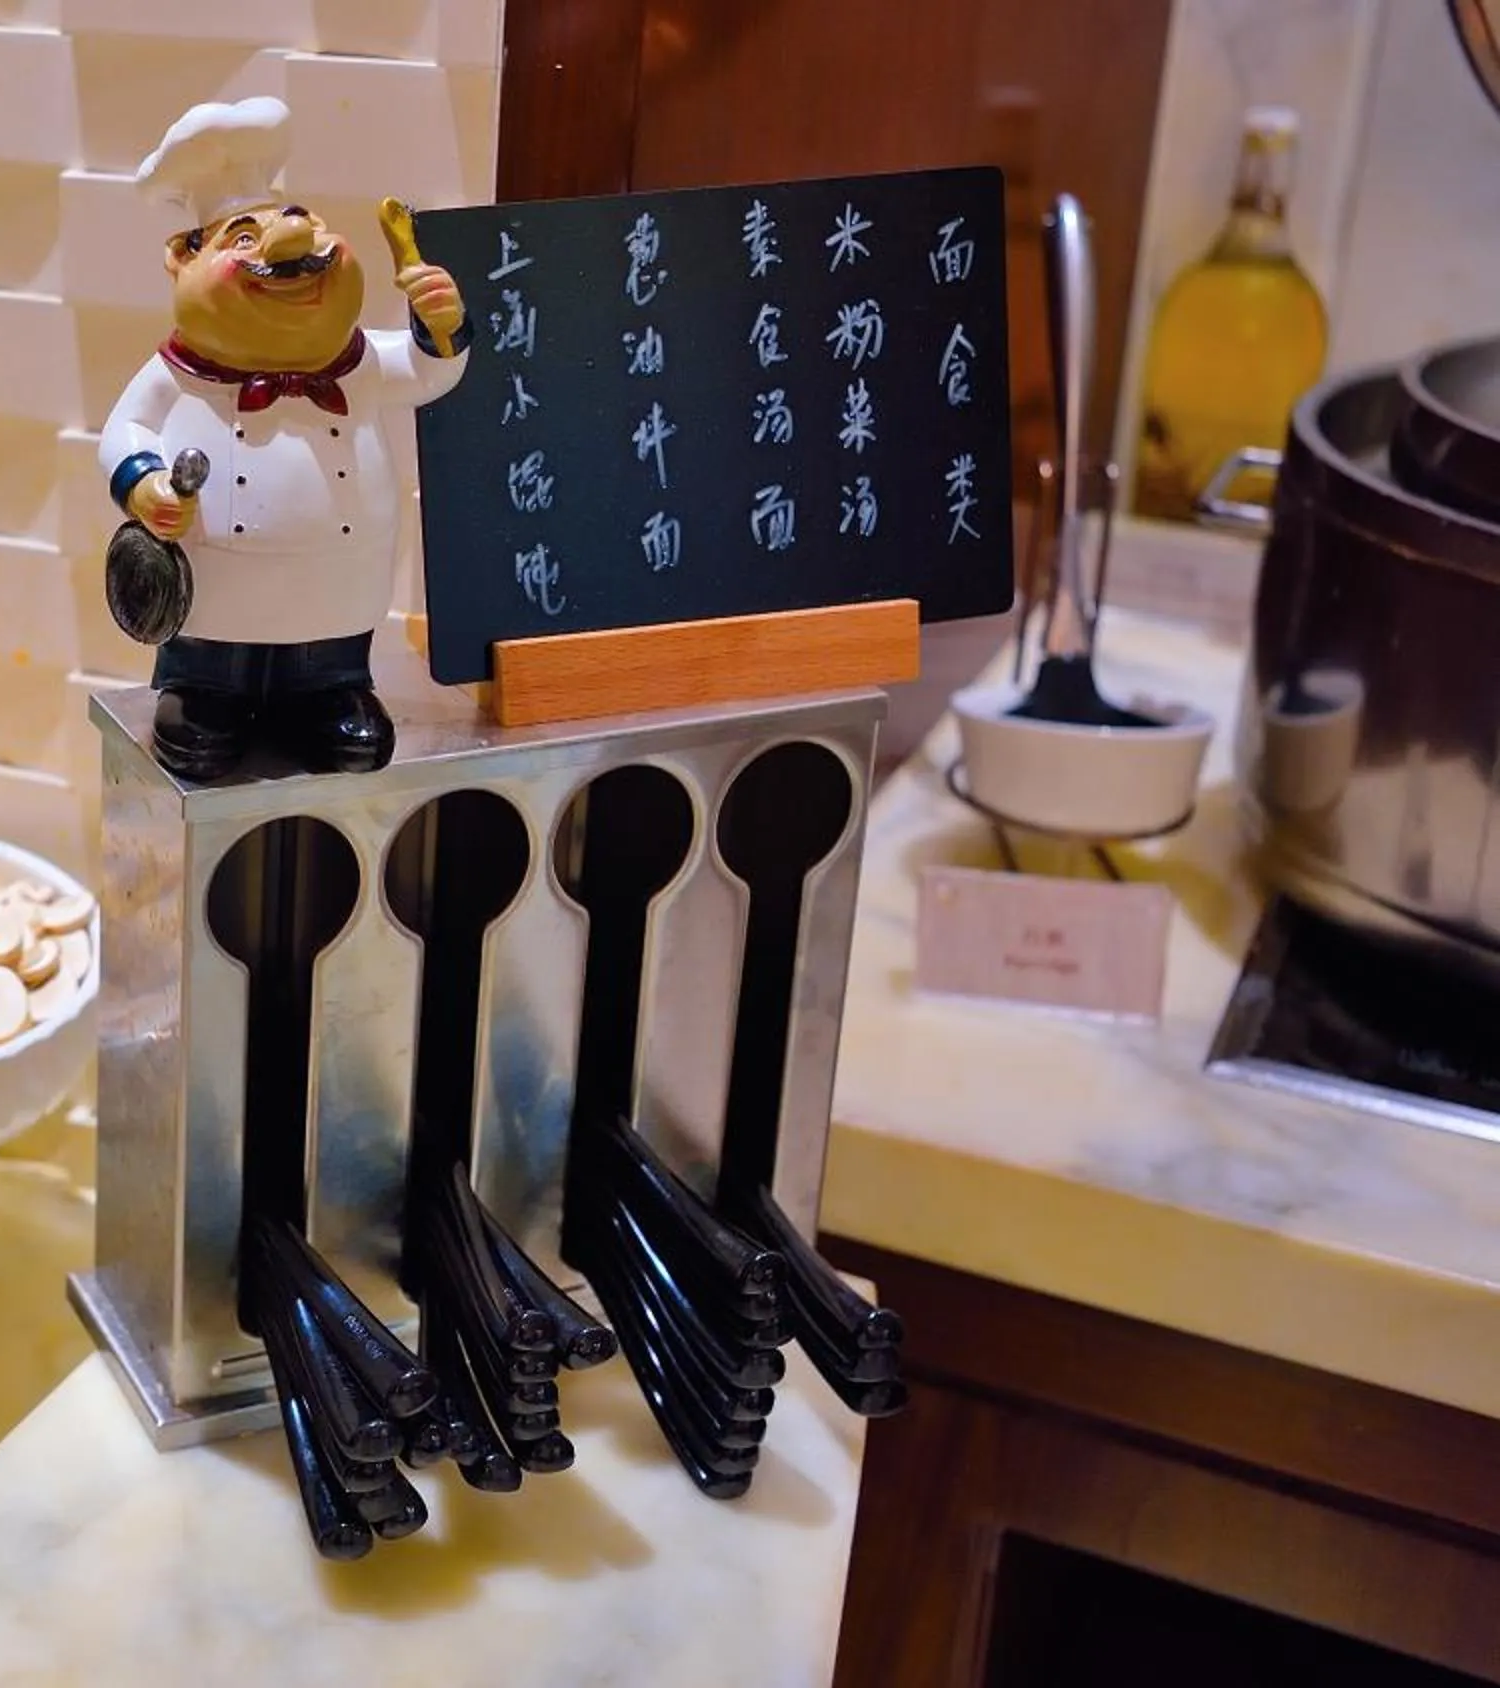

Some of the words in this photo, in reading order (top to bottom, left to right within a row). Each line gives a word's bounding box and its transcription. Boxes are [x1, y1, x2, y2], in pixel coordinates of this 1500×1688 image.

[621, 211, 682, 572] 葱油拌面
[741, 199, 797, 552] 素食汤面
[825, 202, 884, 537] 米粉菜汤
[929, 217, 981, 545] 面食类
